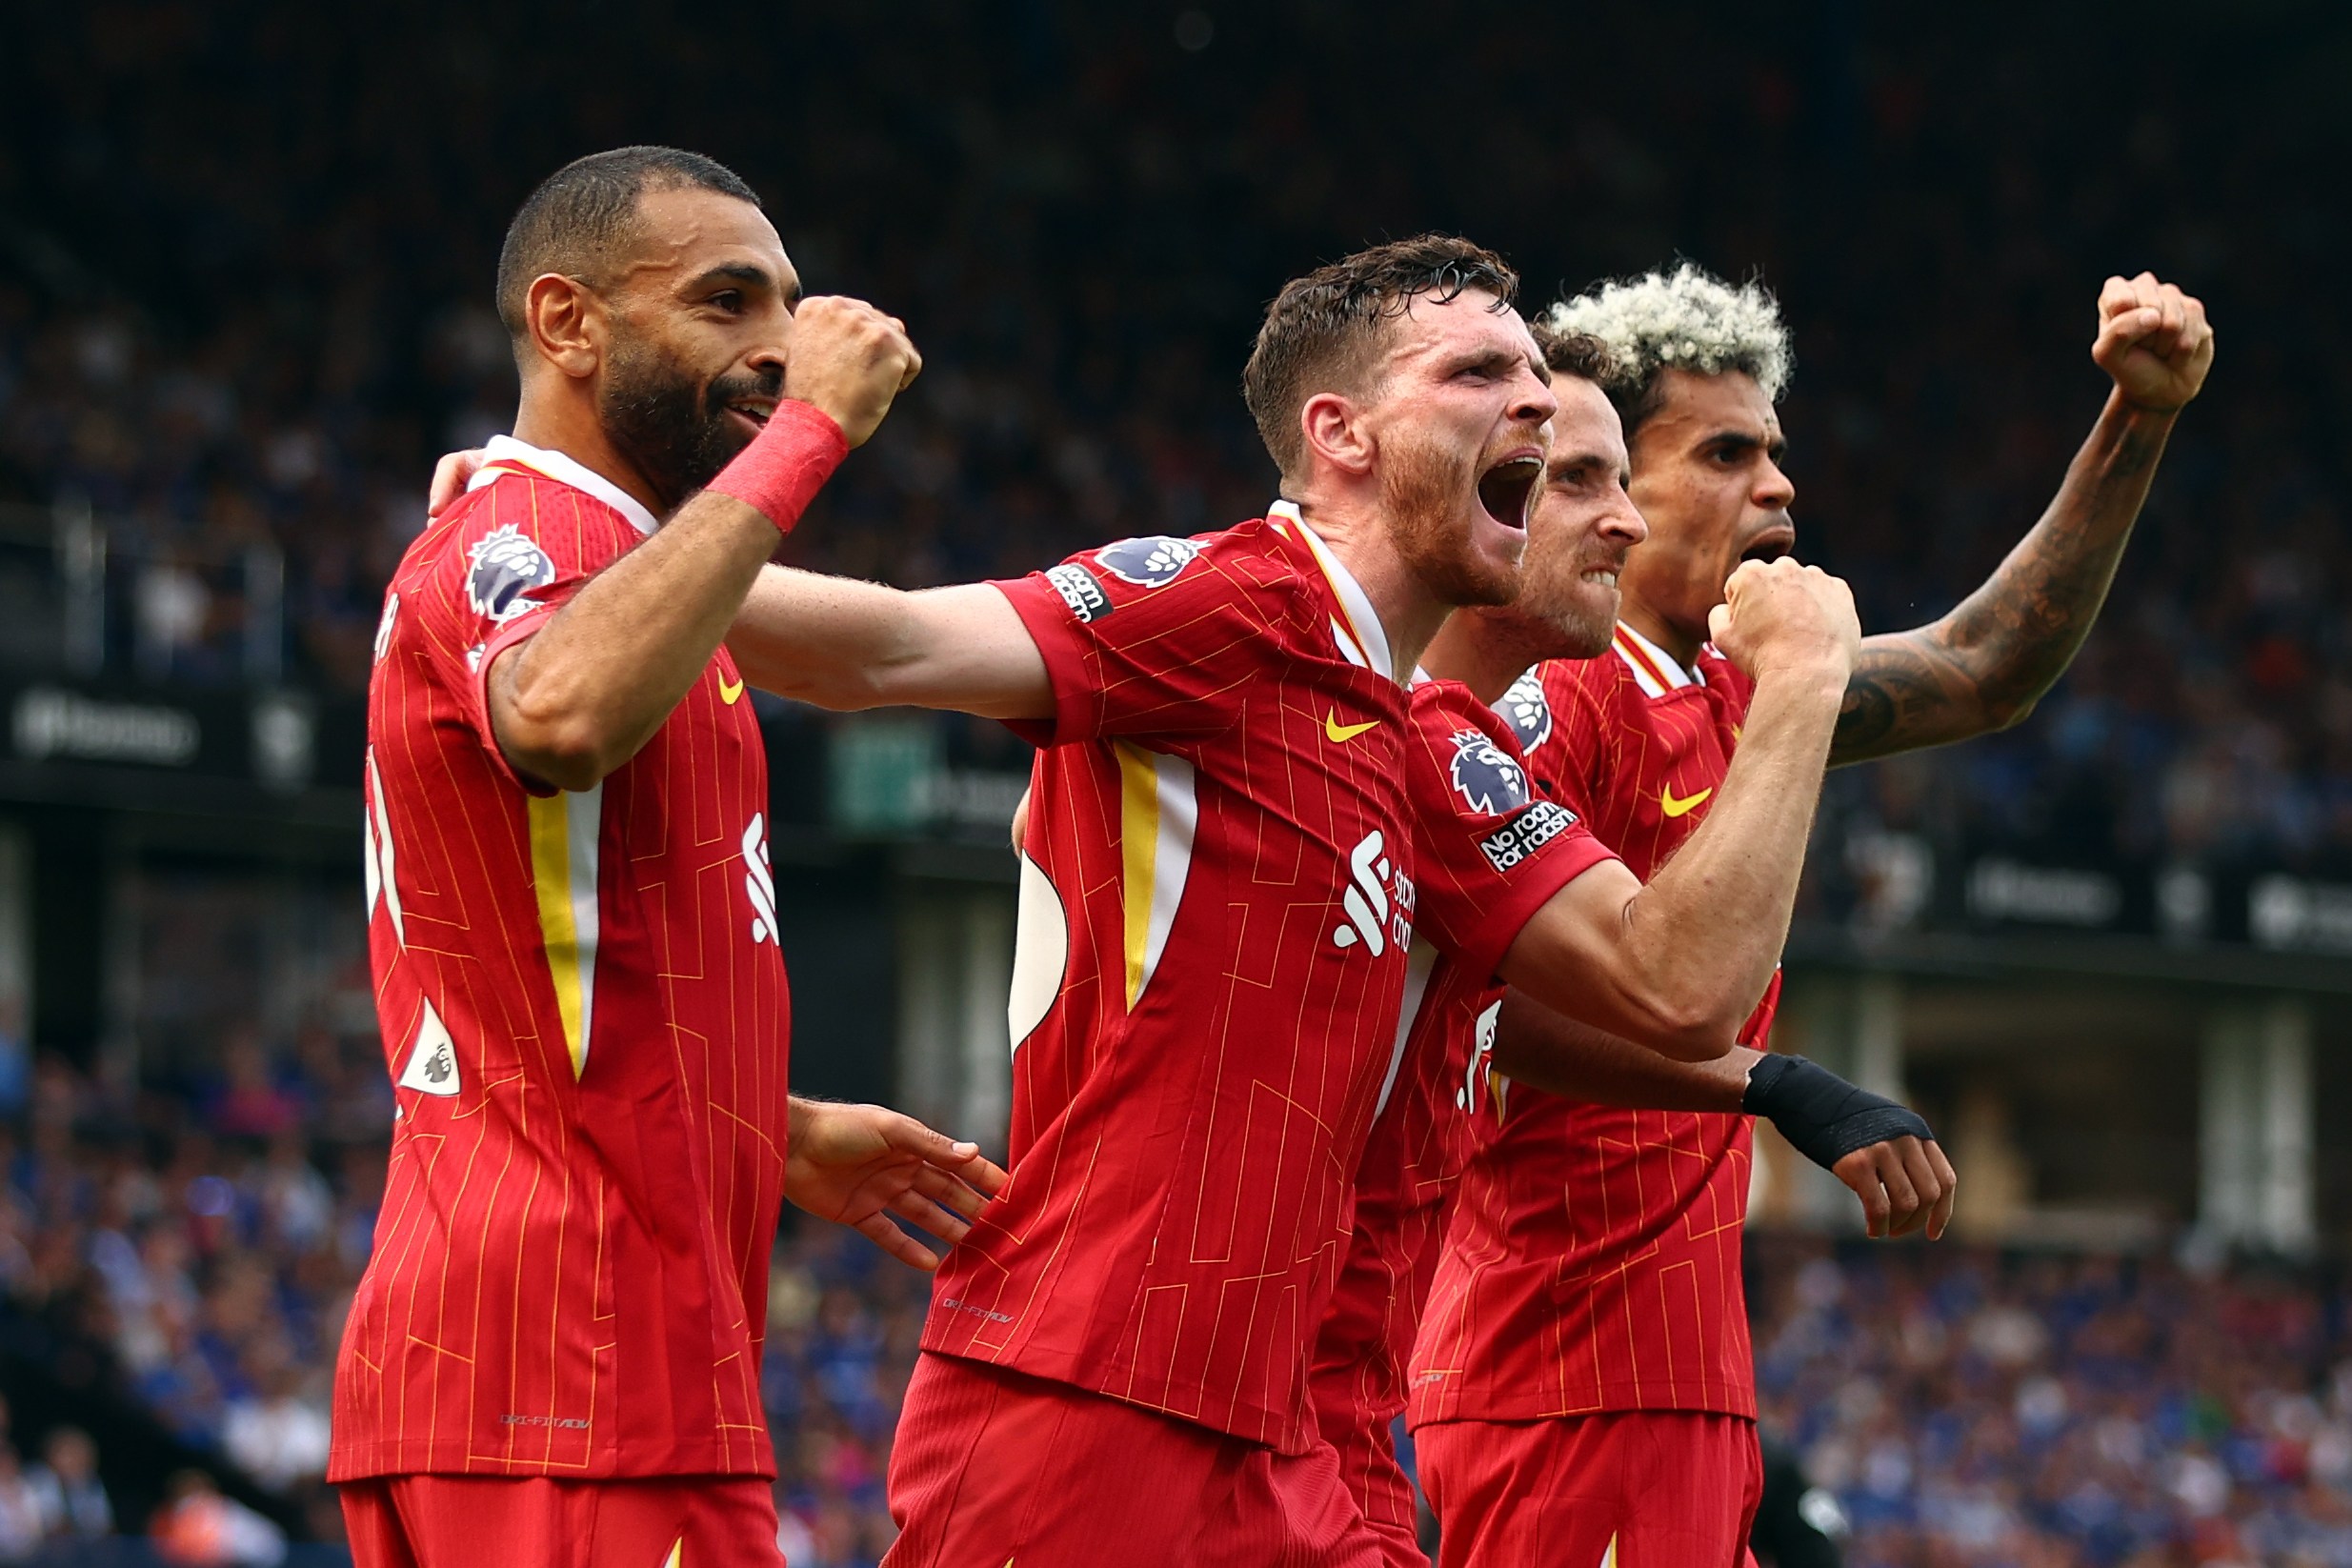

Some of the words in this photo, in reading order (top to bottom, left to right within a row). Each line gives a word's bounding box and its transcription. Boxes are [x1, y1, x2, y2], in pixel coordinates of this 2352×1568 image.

[1481, 831, 1515, 859] No
[1512, 801, 1560, 837] room
[1492, 844, 1524, 872] for
[1522, 809, 1578, 852] racism
